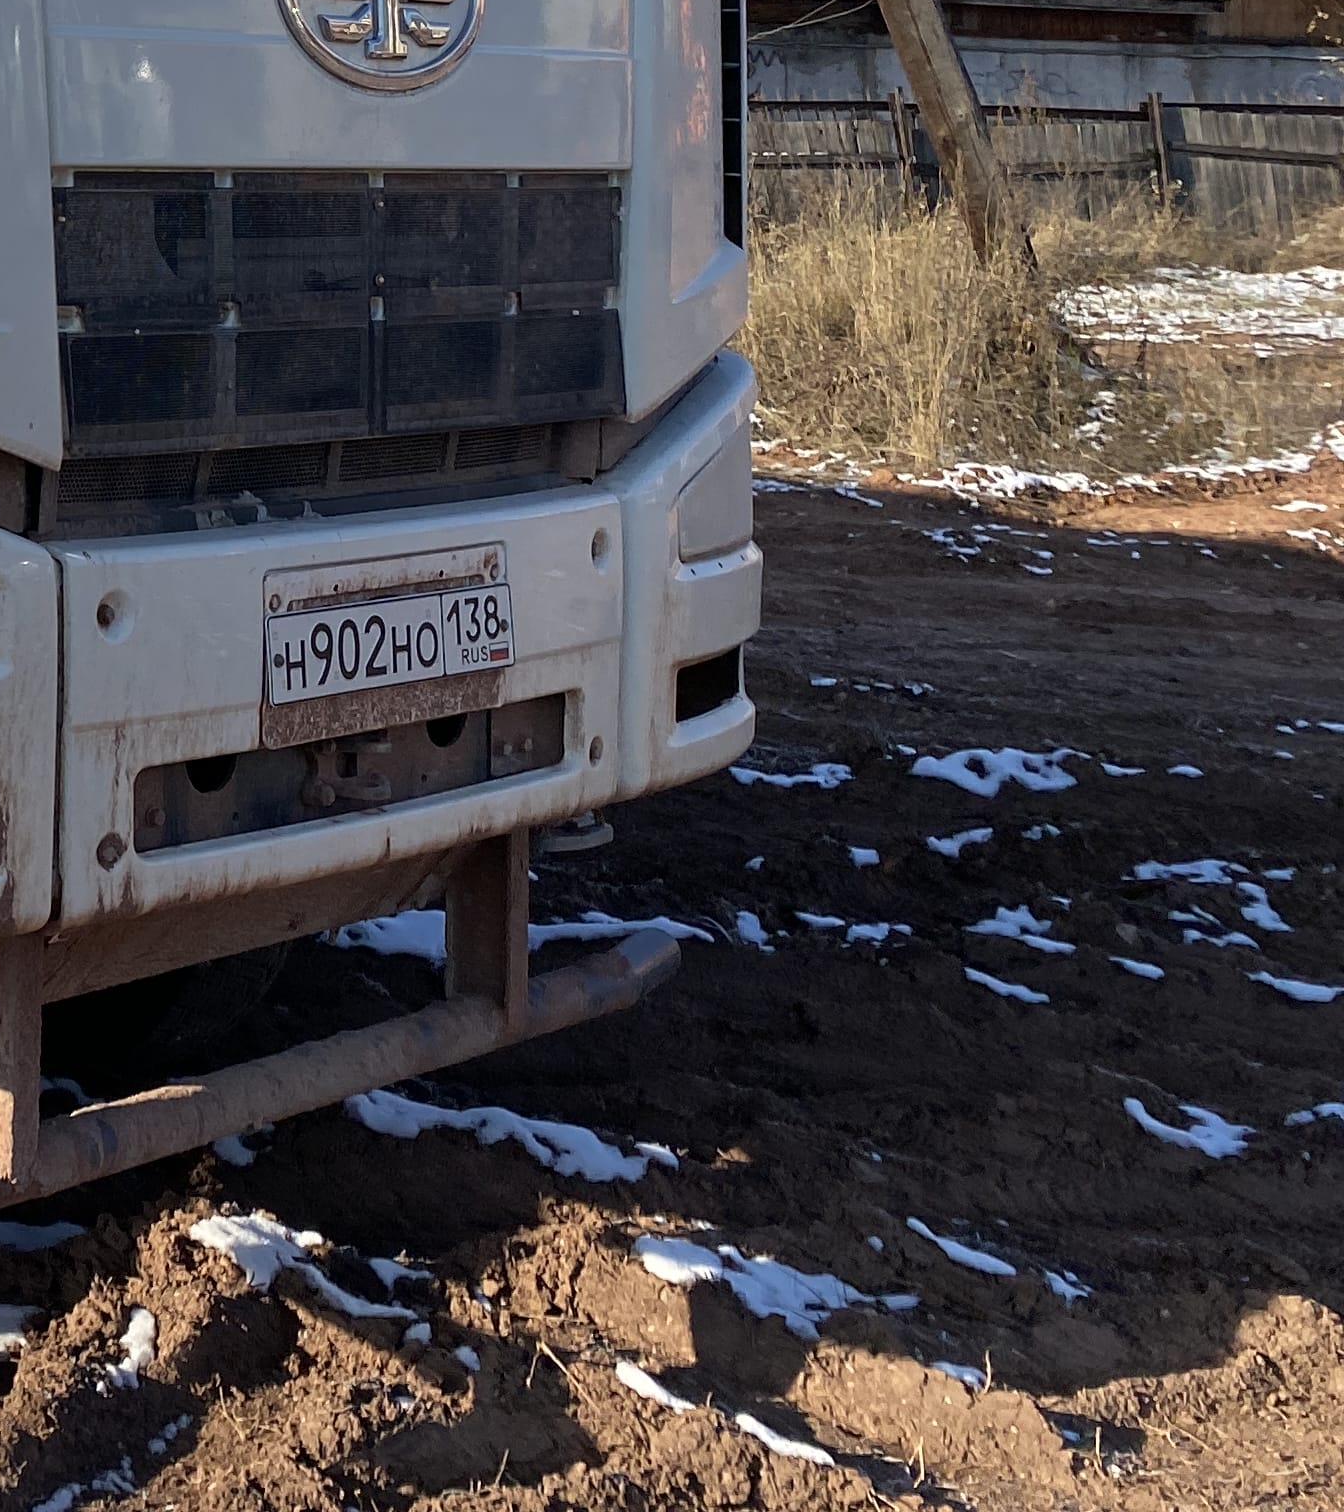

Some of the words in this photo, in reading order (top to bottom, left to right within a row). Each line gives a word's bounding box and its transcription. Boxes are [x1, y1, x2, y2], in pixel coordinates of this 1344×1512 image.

[284, 614, 439, 691] Н902НО
[446, 594, 501, 646] 138
[461, 645, 489, 665] RUS
